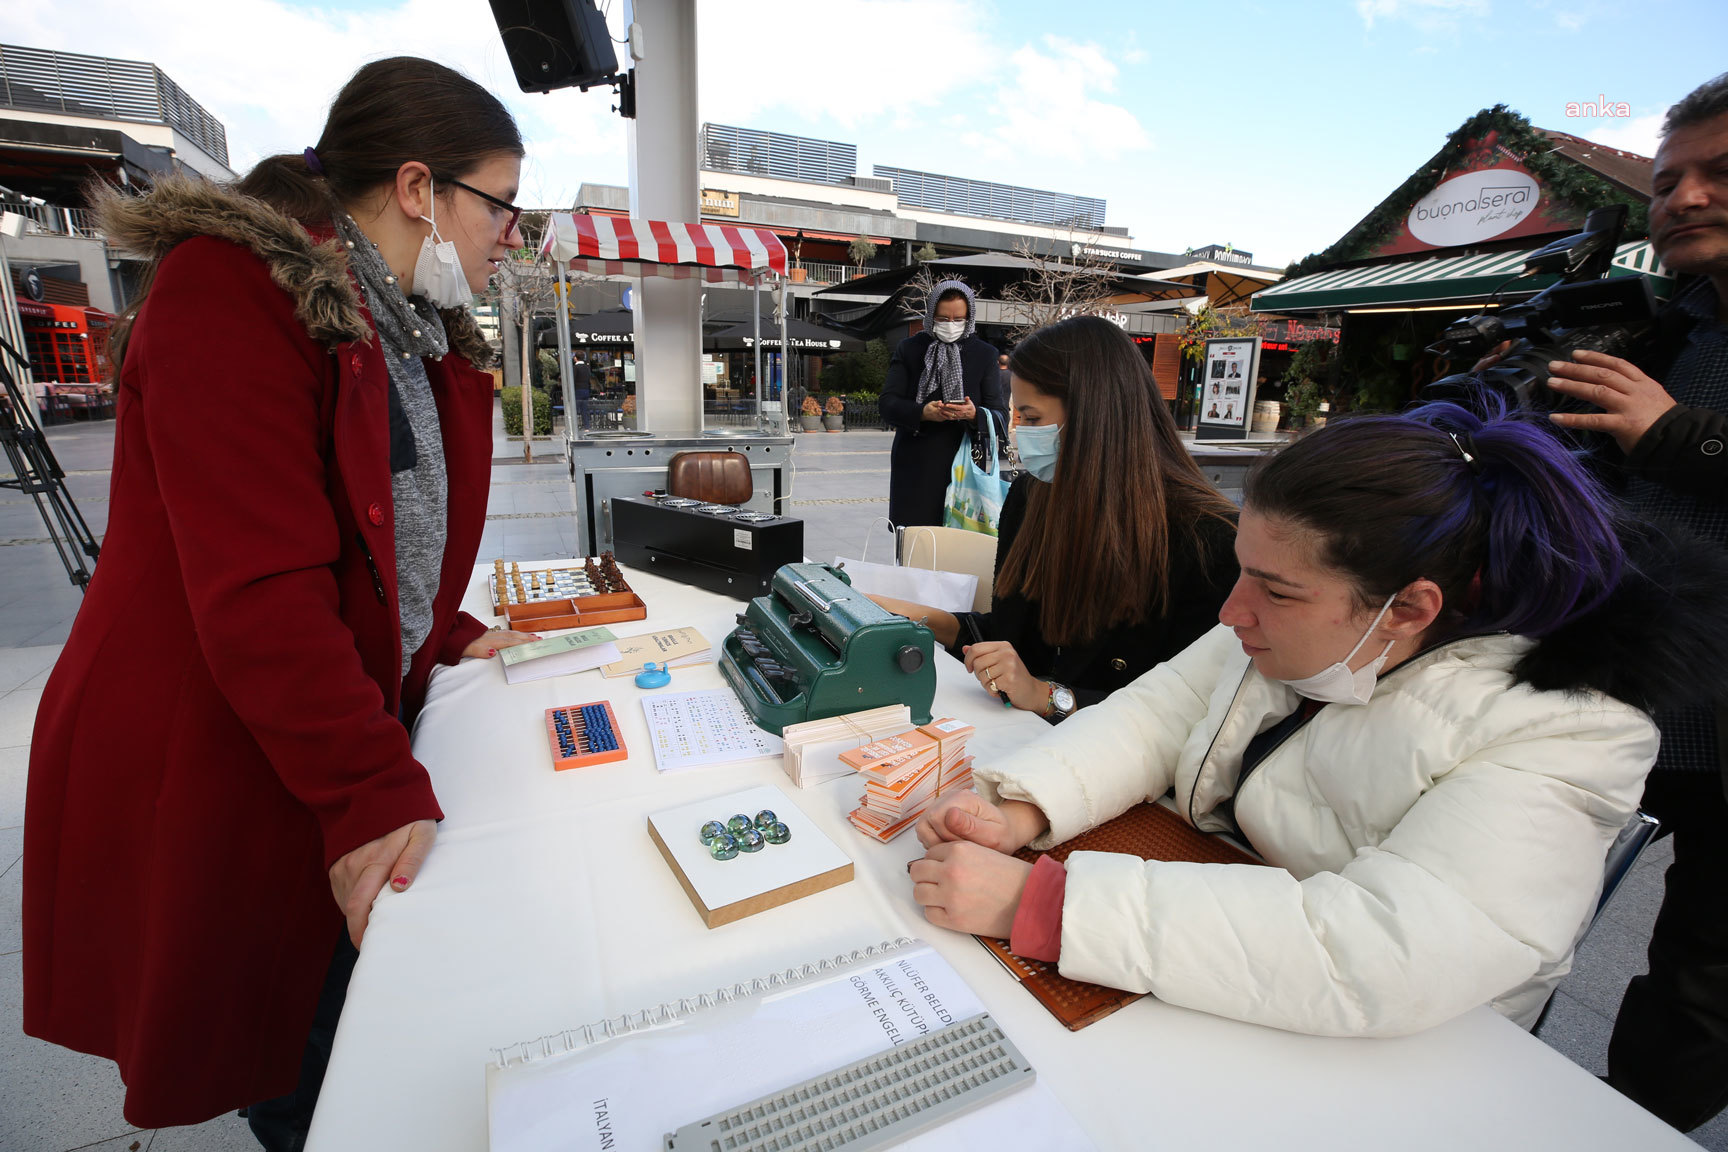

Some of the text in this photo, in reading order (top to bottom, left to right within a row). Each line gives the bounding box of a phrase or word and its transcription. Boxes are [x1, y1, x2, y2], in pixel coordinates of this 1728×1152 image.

[1416, 185, 1531, 221] buonasera
[1119, 251, 1142, 260] COFFEE
[591, 332, 621, 342] COFFEE
[804, 338, 828, 347] HOUSE
[849, 975, 880, 1008] GÖRME
[896, 959, 929, 993] NİLÜFER
[592, 1097, 616, 1151] İTALYAN
